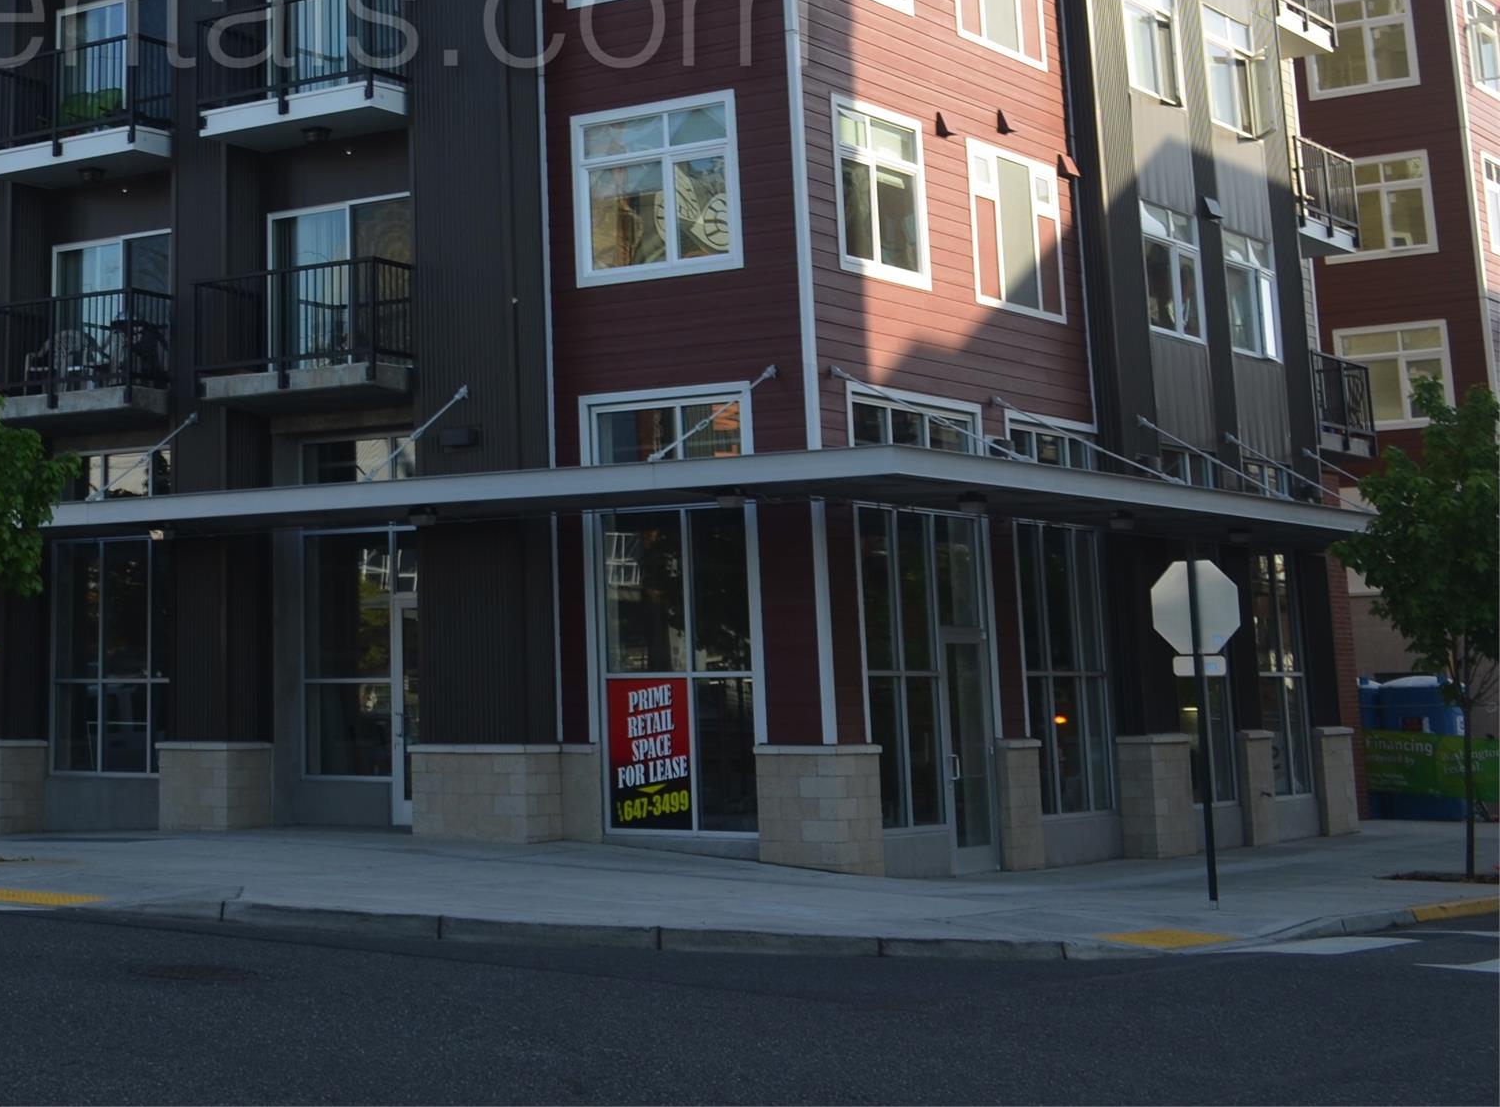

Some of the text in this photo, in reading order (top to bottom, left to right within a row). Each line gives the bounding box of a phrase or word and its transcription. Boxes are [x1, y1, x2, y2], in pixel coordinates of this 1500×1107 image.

[628, 684, 671, 712] PRIME
[627, 710, 674, 738] RETAIL
[631, 734, 672, 762] SPACE
[1366, 737, 1433, 756] Financing
[617, 756, 688, 789] FOR LEASE
[624, 790, 689, 821] 647-3499
